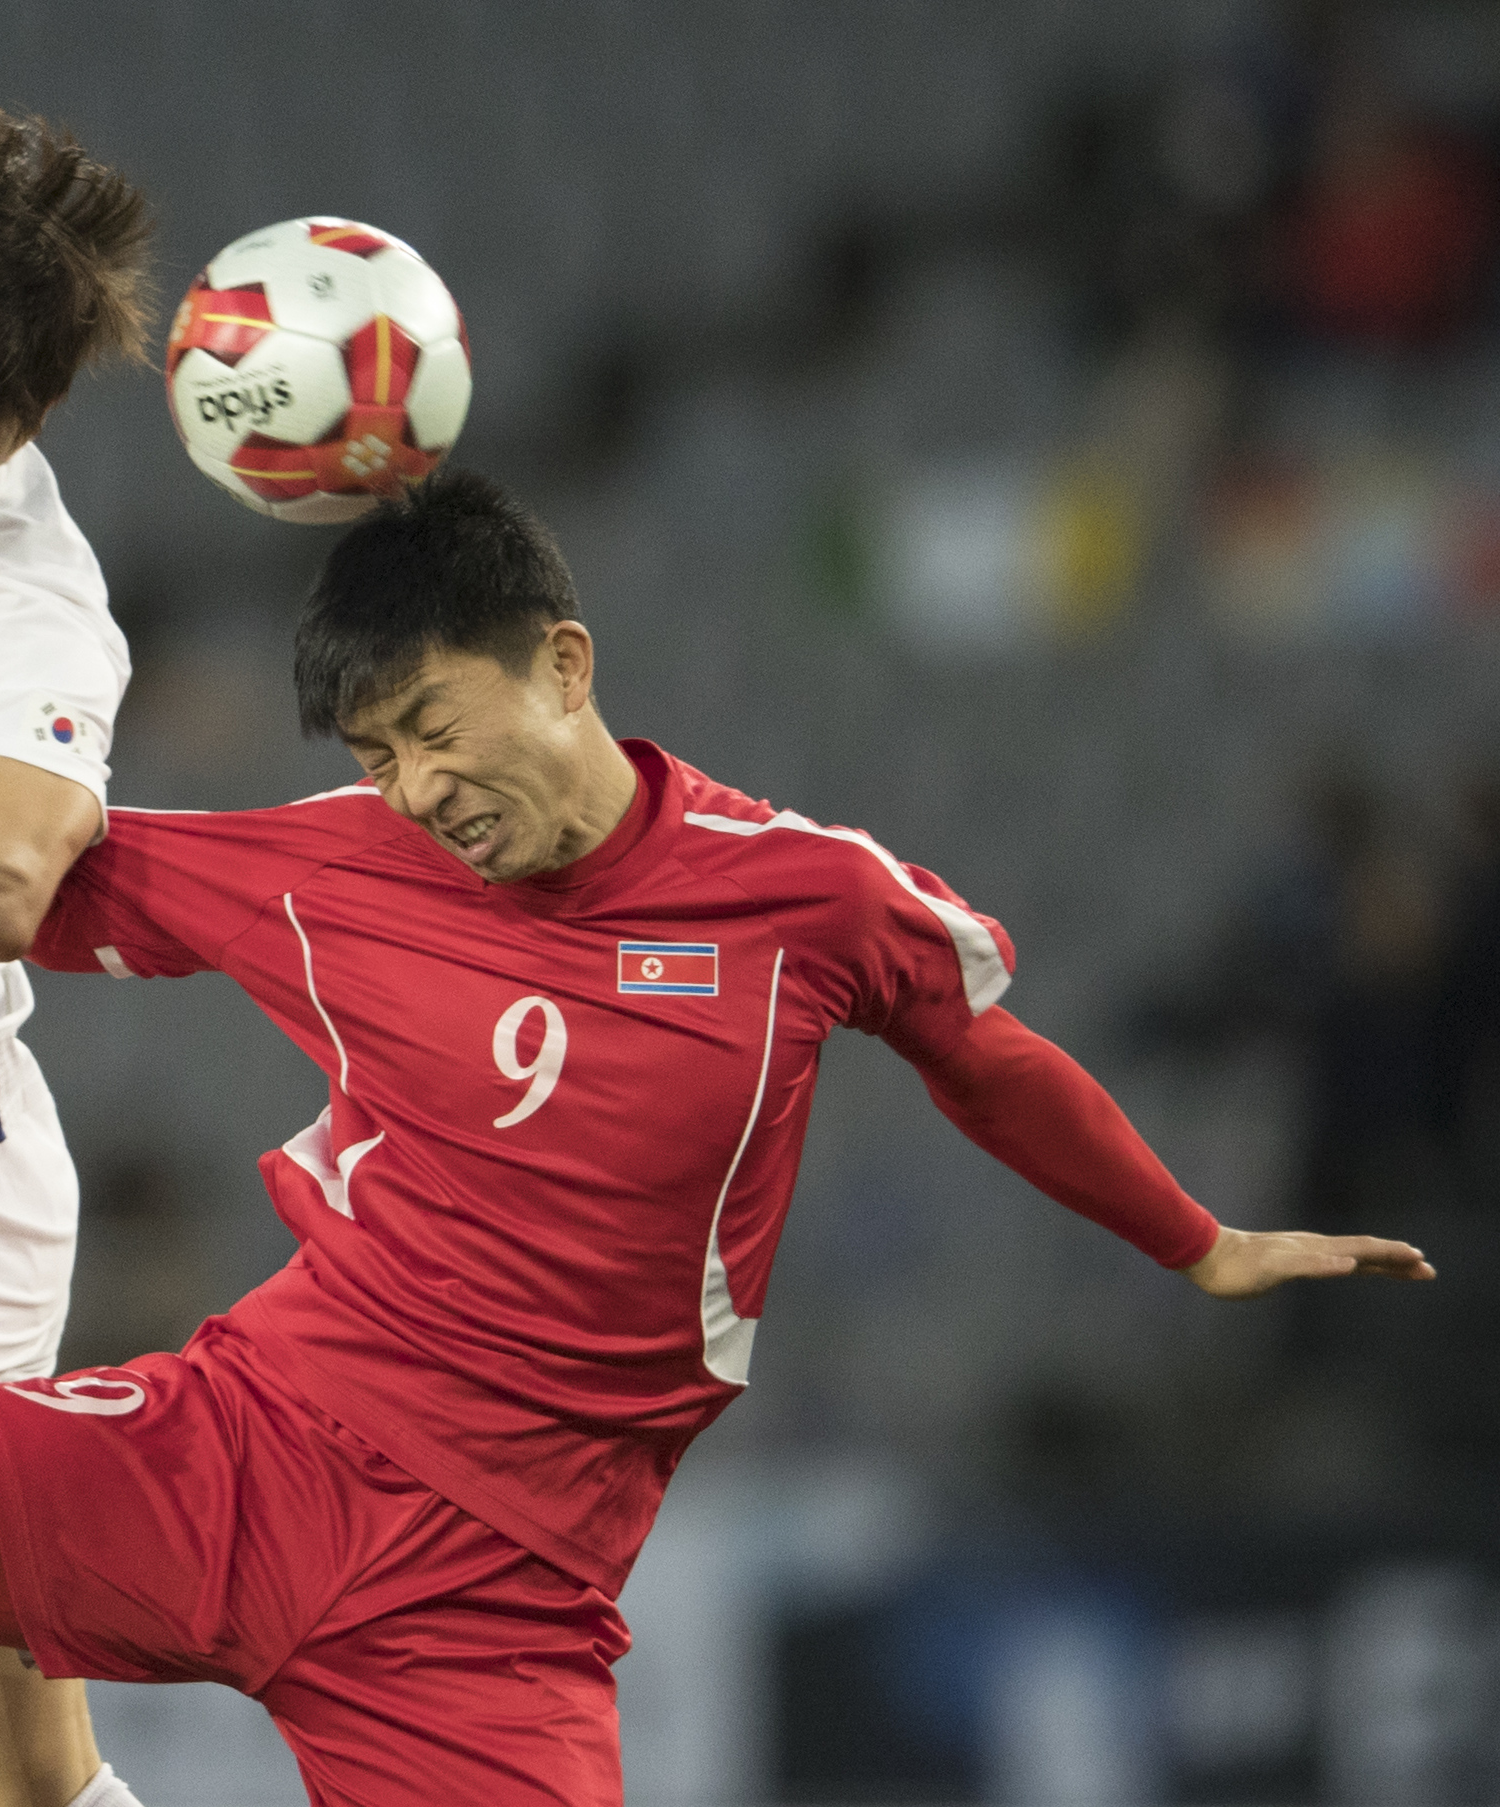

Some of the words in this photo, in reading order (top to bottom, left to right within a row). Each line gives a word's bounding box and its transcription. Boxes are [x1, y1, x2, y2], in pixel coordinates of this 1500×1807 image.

[196, 379, 295, 433] sfida
[492, 996, 568, 1129] 9
[3, 1376, 146, 1416] 9
